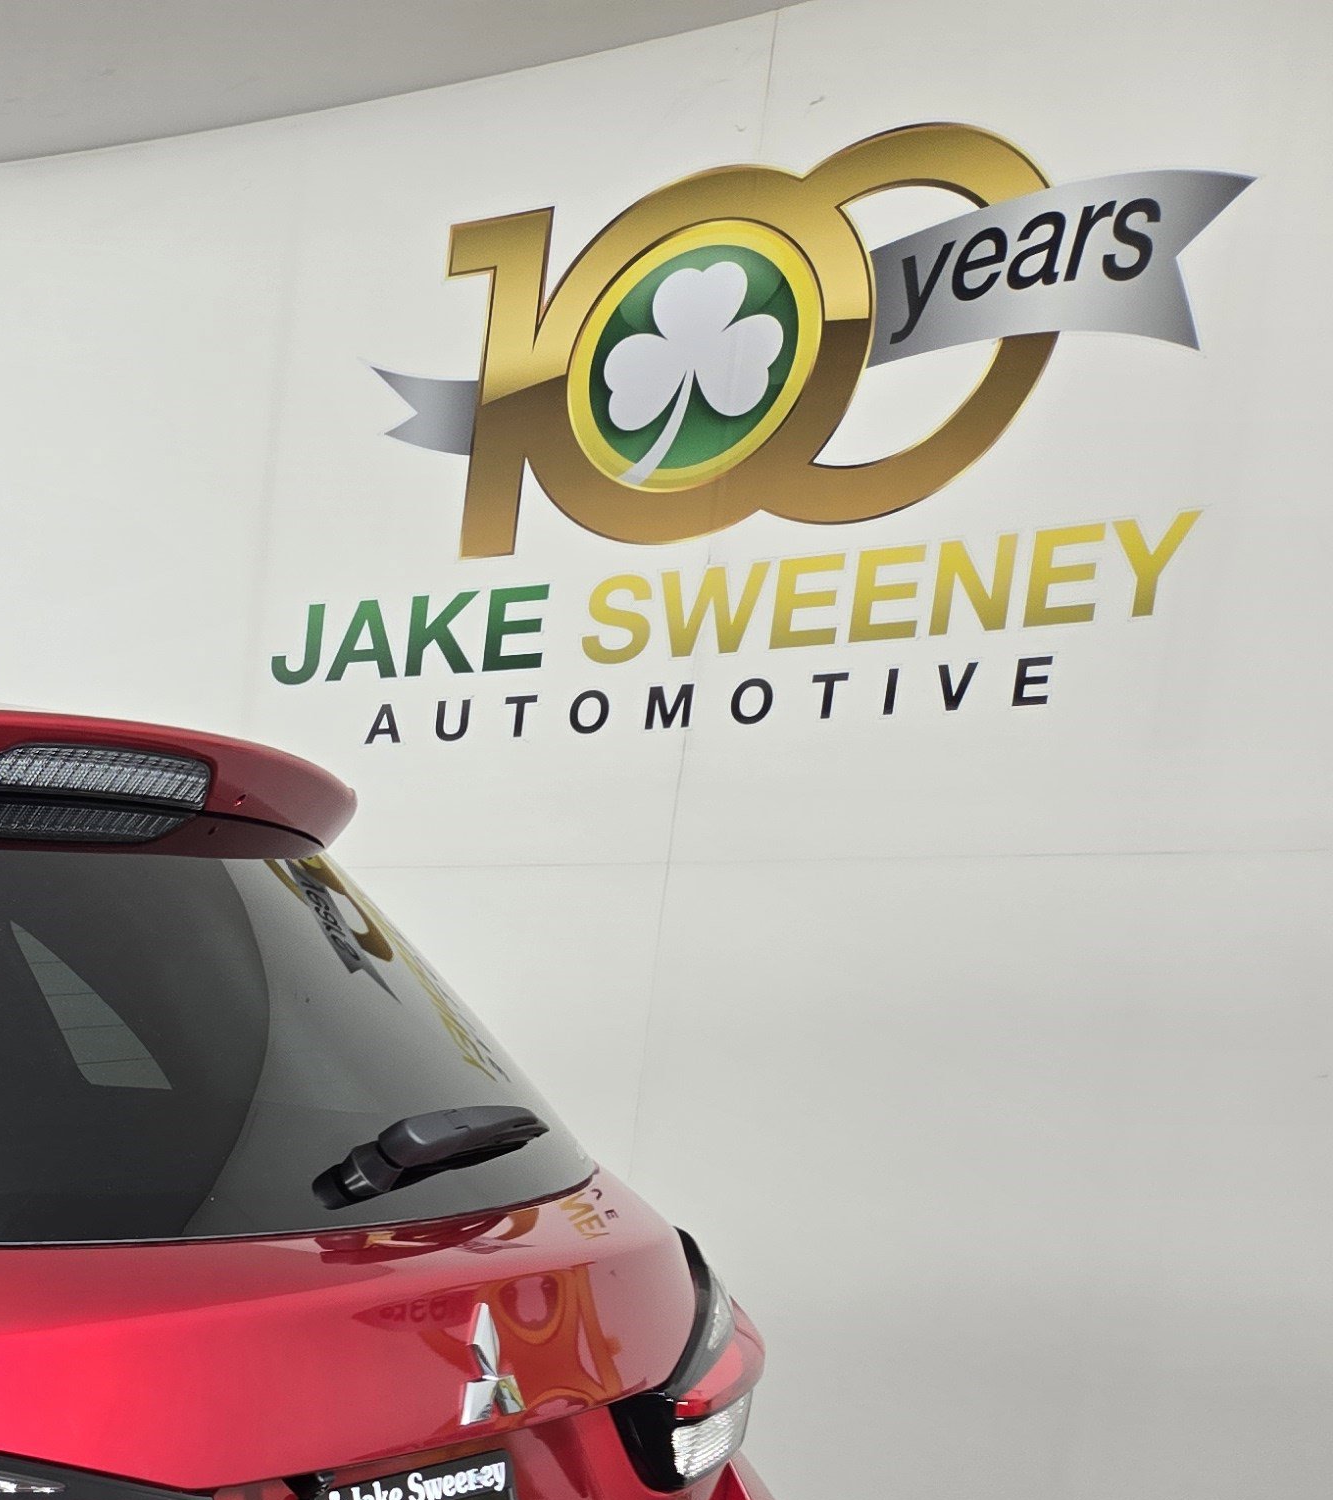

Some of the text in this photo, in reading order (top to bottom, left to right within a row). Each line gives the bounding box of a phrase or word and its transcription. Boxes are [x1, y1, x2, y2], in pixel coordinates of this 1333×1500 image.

[889, 196, 1163, 345] years
[271, 509, 1204, 687] JAKE SWEENEY
[364, 656, 1056, 745] AUTOMOTIVE
